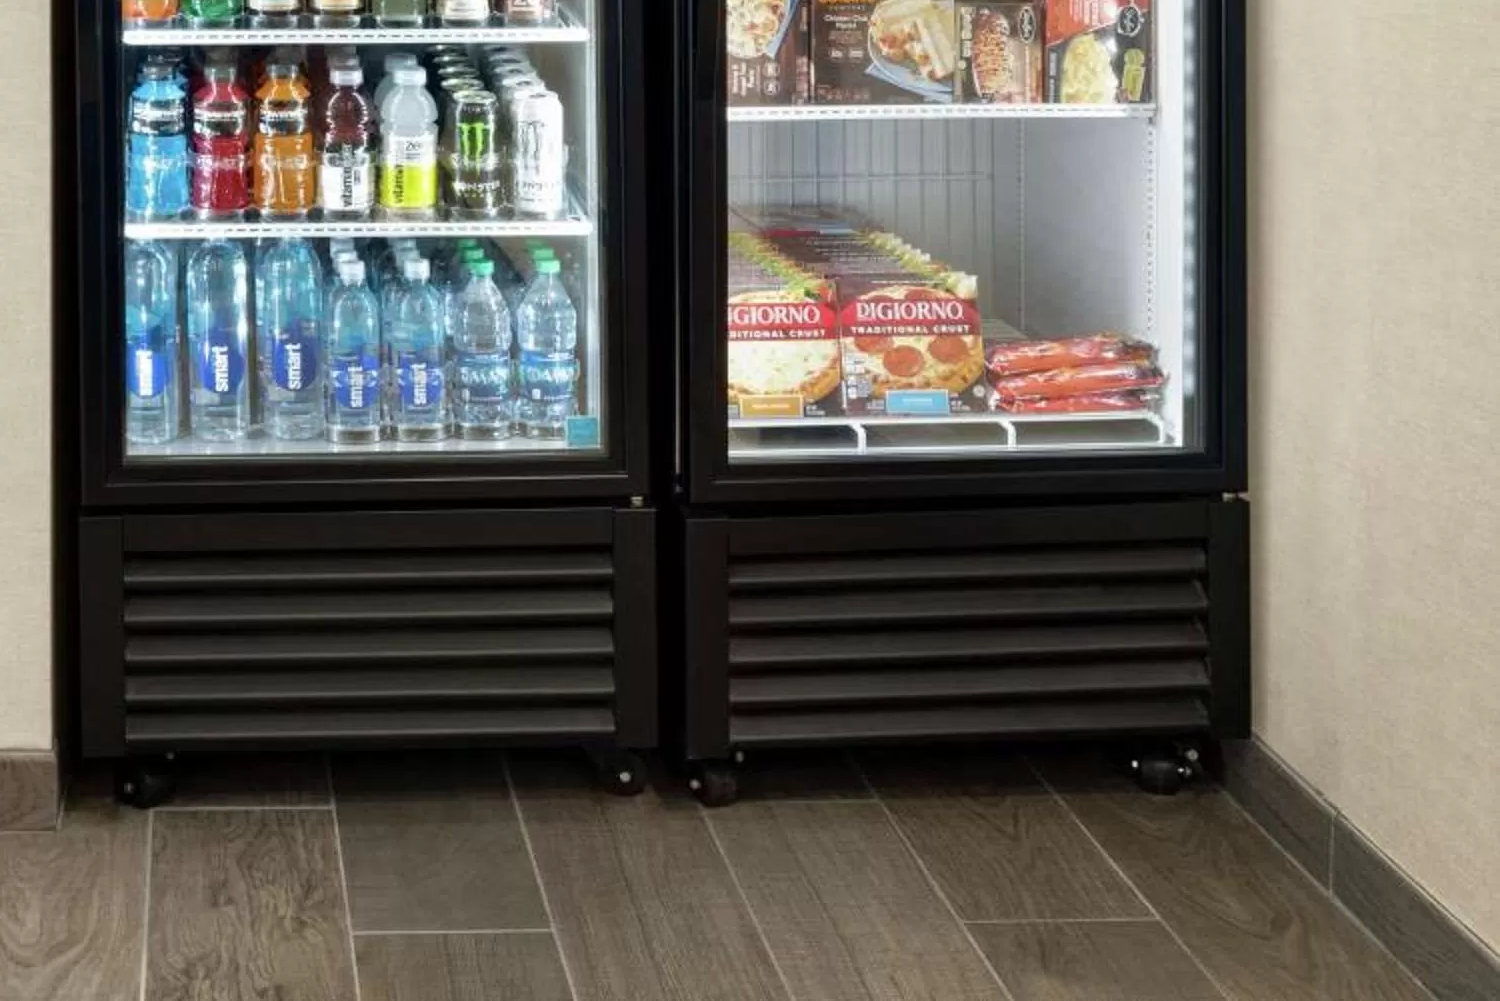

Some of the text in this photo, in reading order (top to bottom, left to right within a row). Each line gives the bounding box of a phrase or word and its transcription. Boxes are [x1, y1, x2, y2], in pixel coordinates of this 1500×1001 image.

[728, 304, 821, 325] IGIORNO
[856, 300, 964, 321] DIGIORNO
[729, 329, 826, 338] DITIONAL CRUST
[851, 324, 970, 335] TRADITIONAL CRUST
[211, 345, 230, 393] smart
[284, 342, 303, 391] smart
[347, 365, 364, 409] smart
[411, 362, 428, 406] smart
